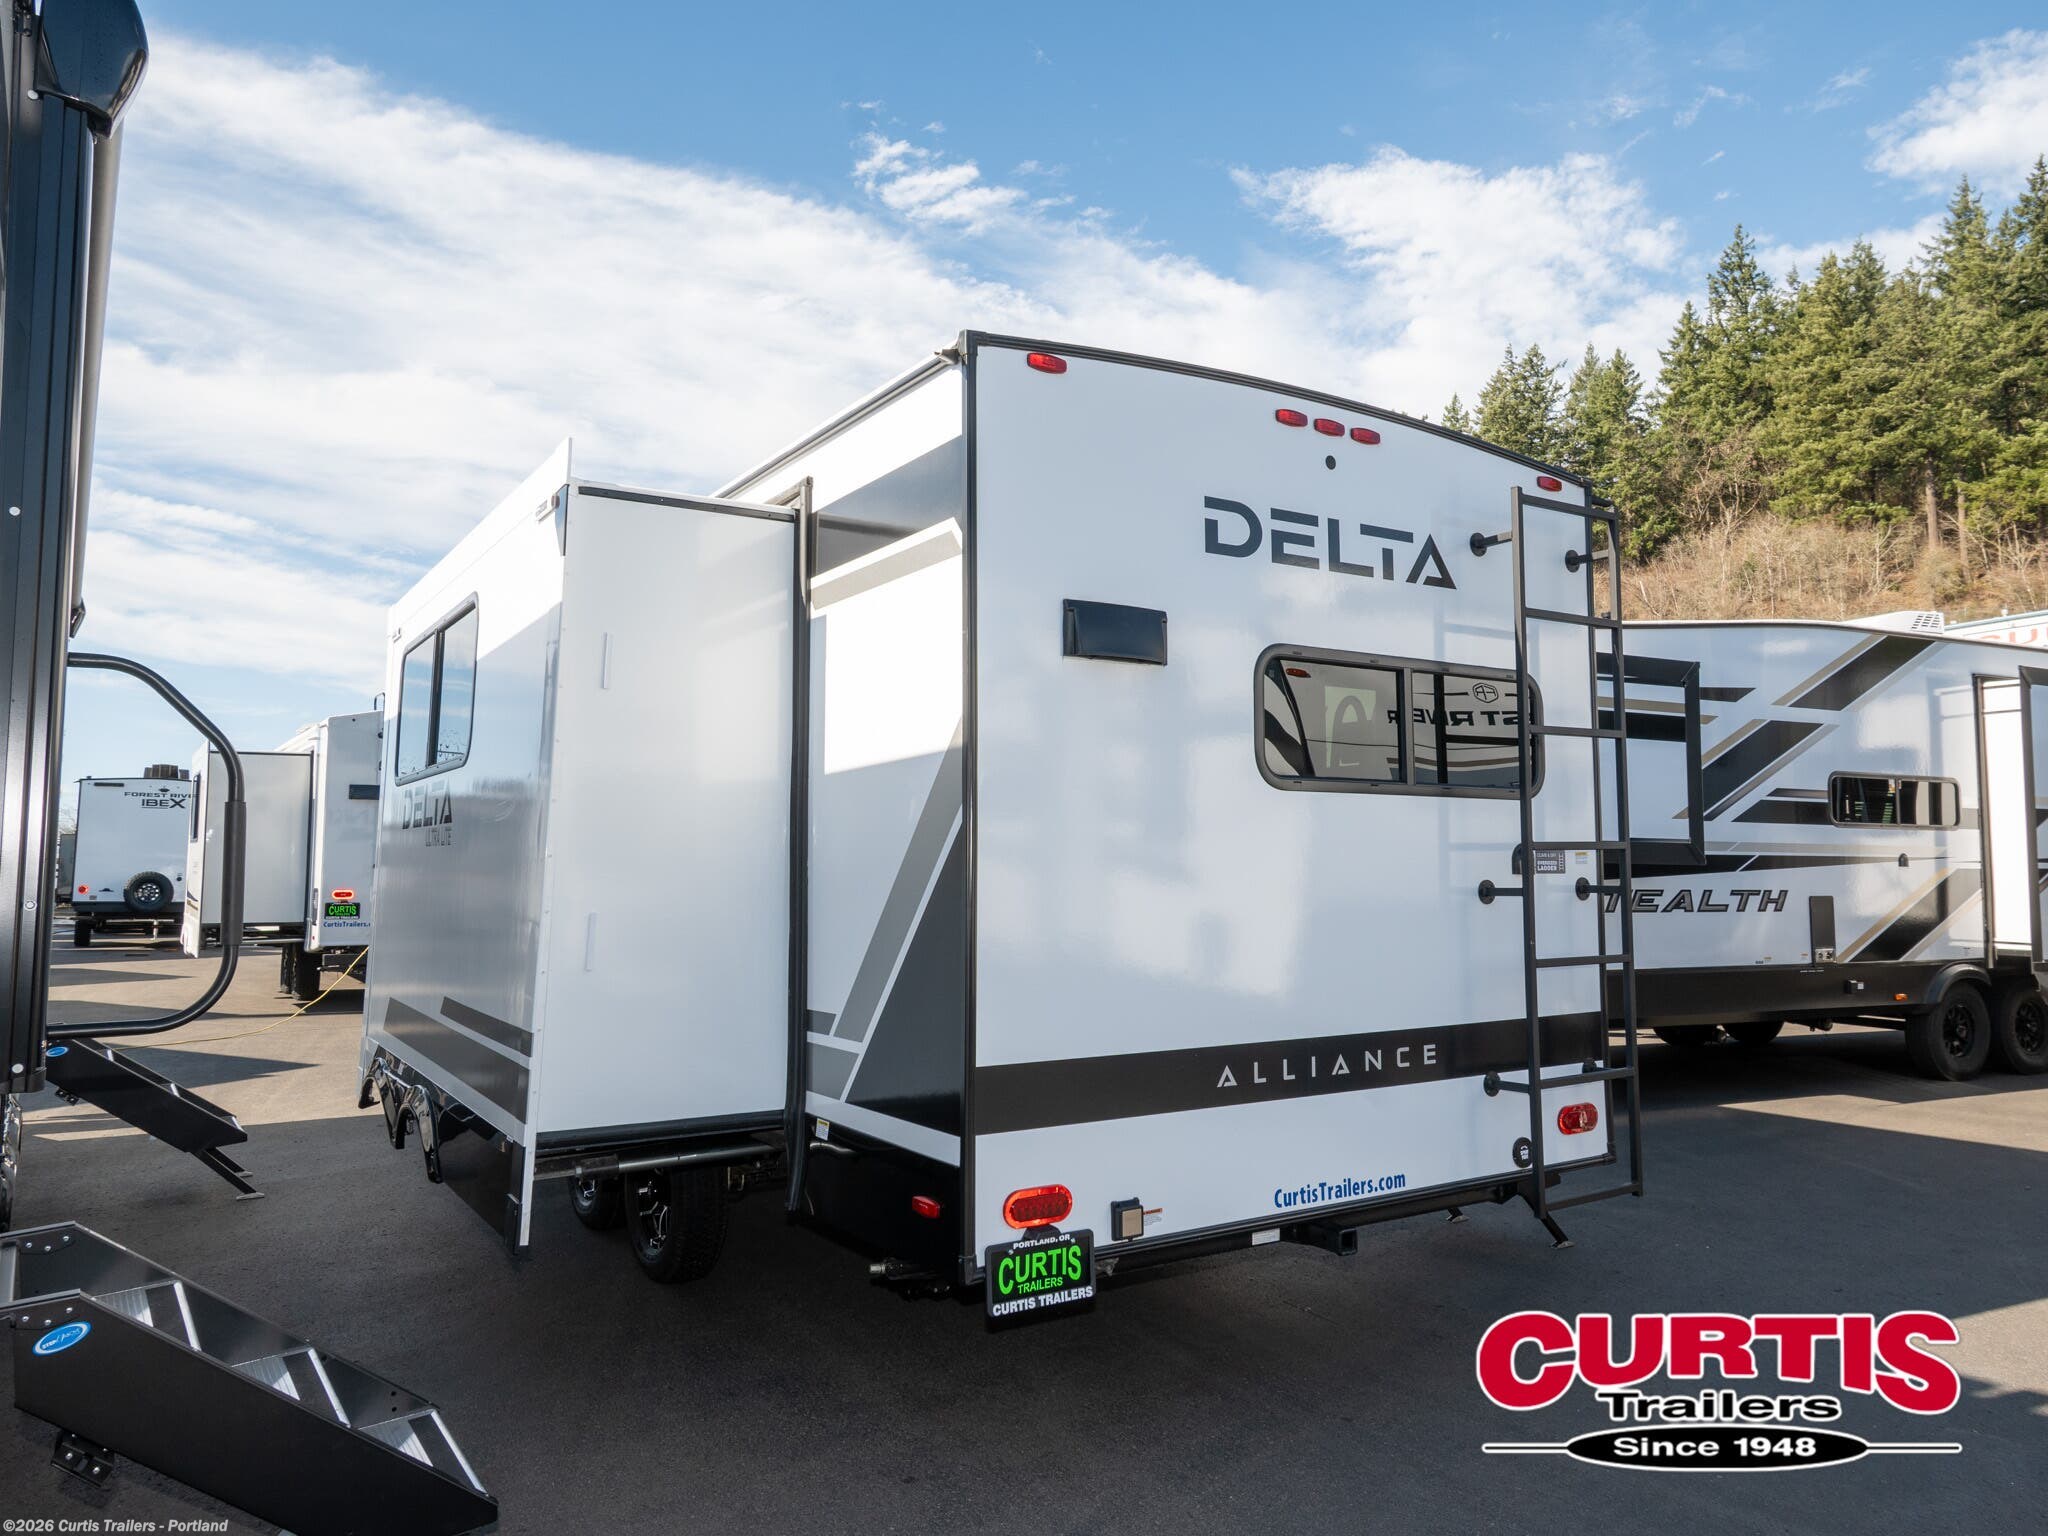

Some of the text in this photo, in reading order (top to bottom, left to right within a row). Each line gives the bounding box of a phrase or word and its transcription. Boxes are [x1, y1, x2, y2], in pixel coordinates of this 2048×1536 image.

[1204, 496, 1457, 590] DELTA
[141, 798, 187, 809] IBEX
[402, 778, 453, 830] DELTA
[328, 905, 357, 916] CURTIS
[1601, 889, 1789, 913] TEALTH
[1217, 1043, 1437, 1088] ALLIANCE
[1274, 1173, 1406, 1208] CurtisTrailers.com
[1013, 1234, 1070, 1249] PORTLAND, OR
[999, 1245, 1082, 1295] CURTIS
[1017, 1277, 1063, 1294] TRAILERS
[992, 1285, 1094, 1317] CURTIS TRAILERS
